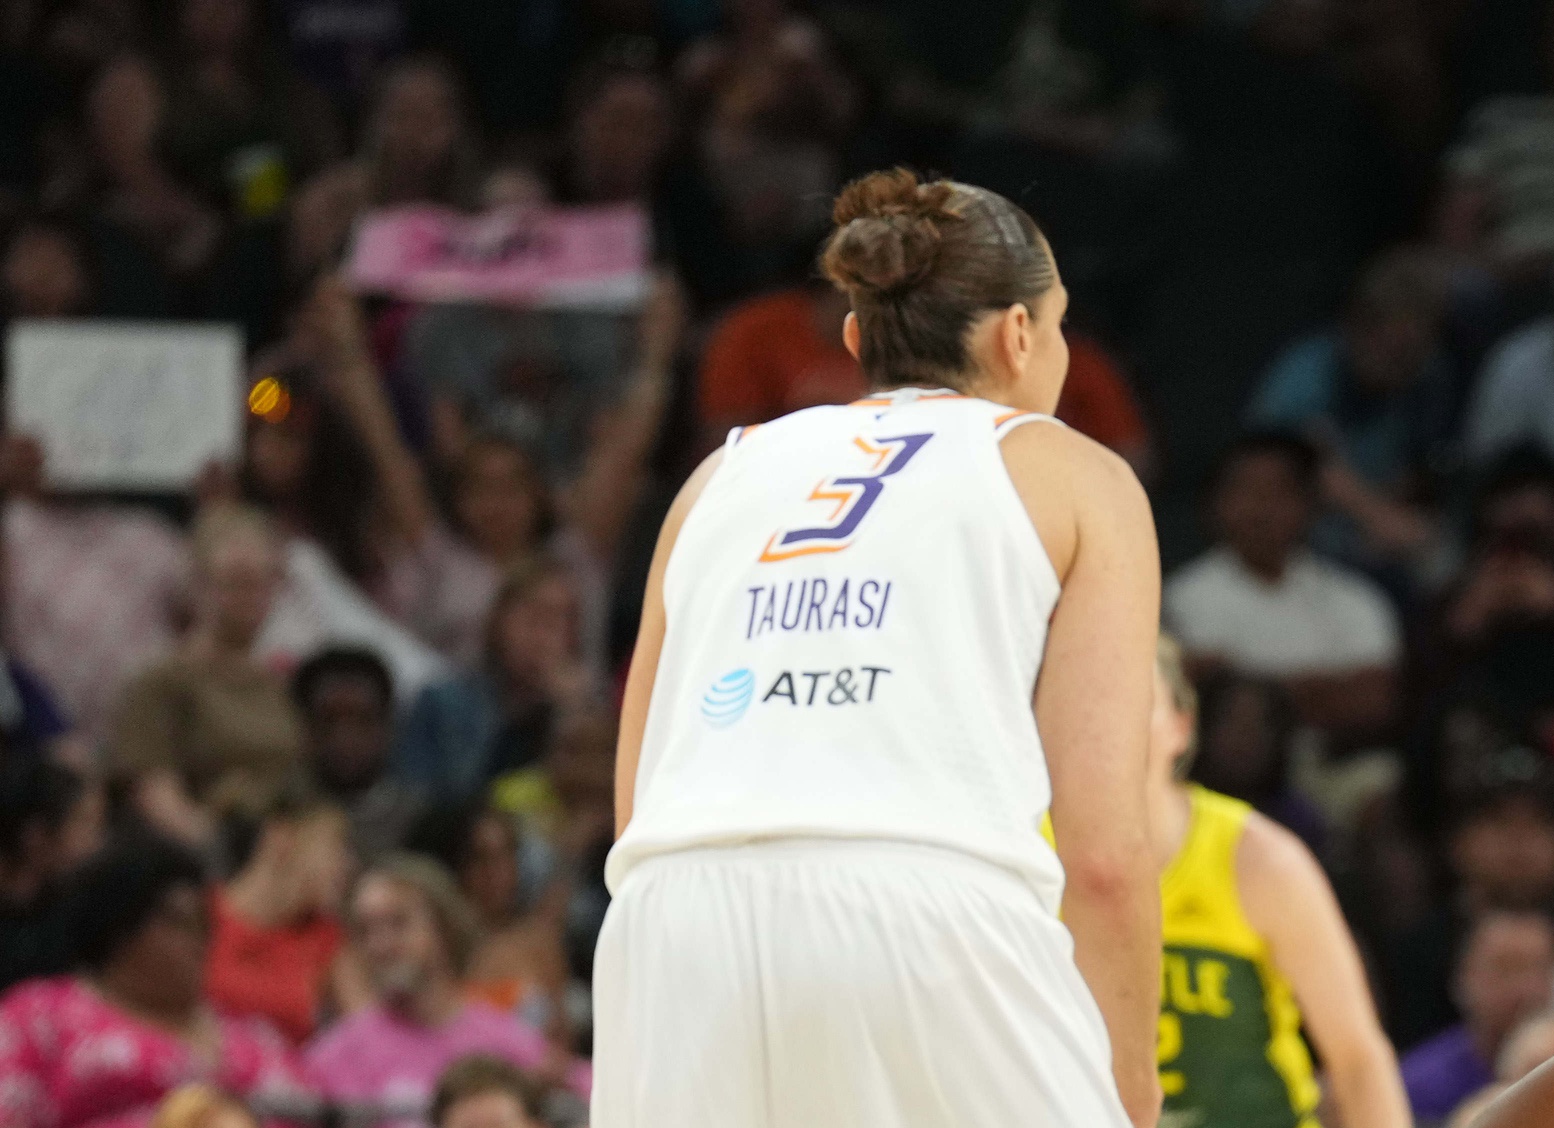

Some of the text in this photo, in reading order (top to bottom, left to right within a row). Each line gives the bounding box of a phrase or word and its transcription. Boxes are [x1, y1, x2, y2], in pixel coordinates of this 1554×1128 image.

[758, 433, 934, 563] 3
[745, 577, 893, 640] TAURASI
[761, 665, 893, 708] AT&T
